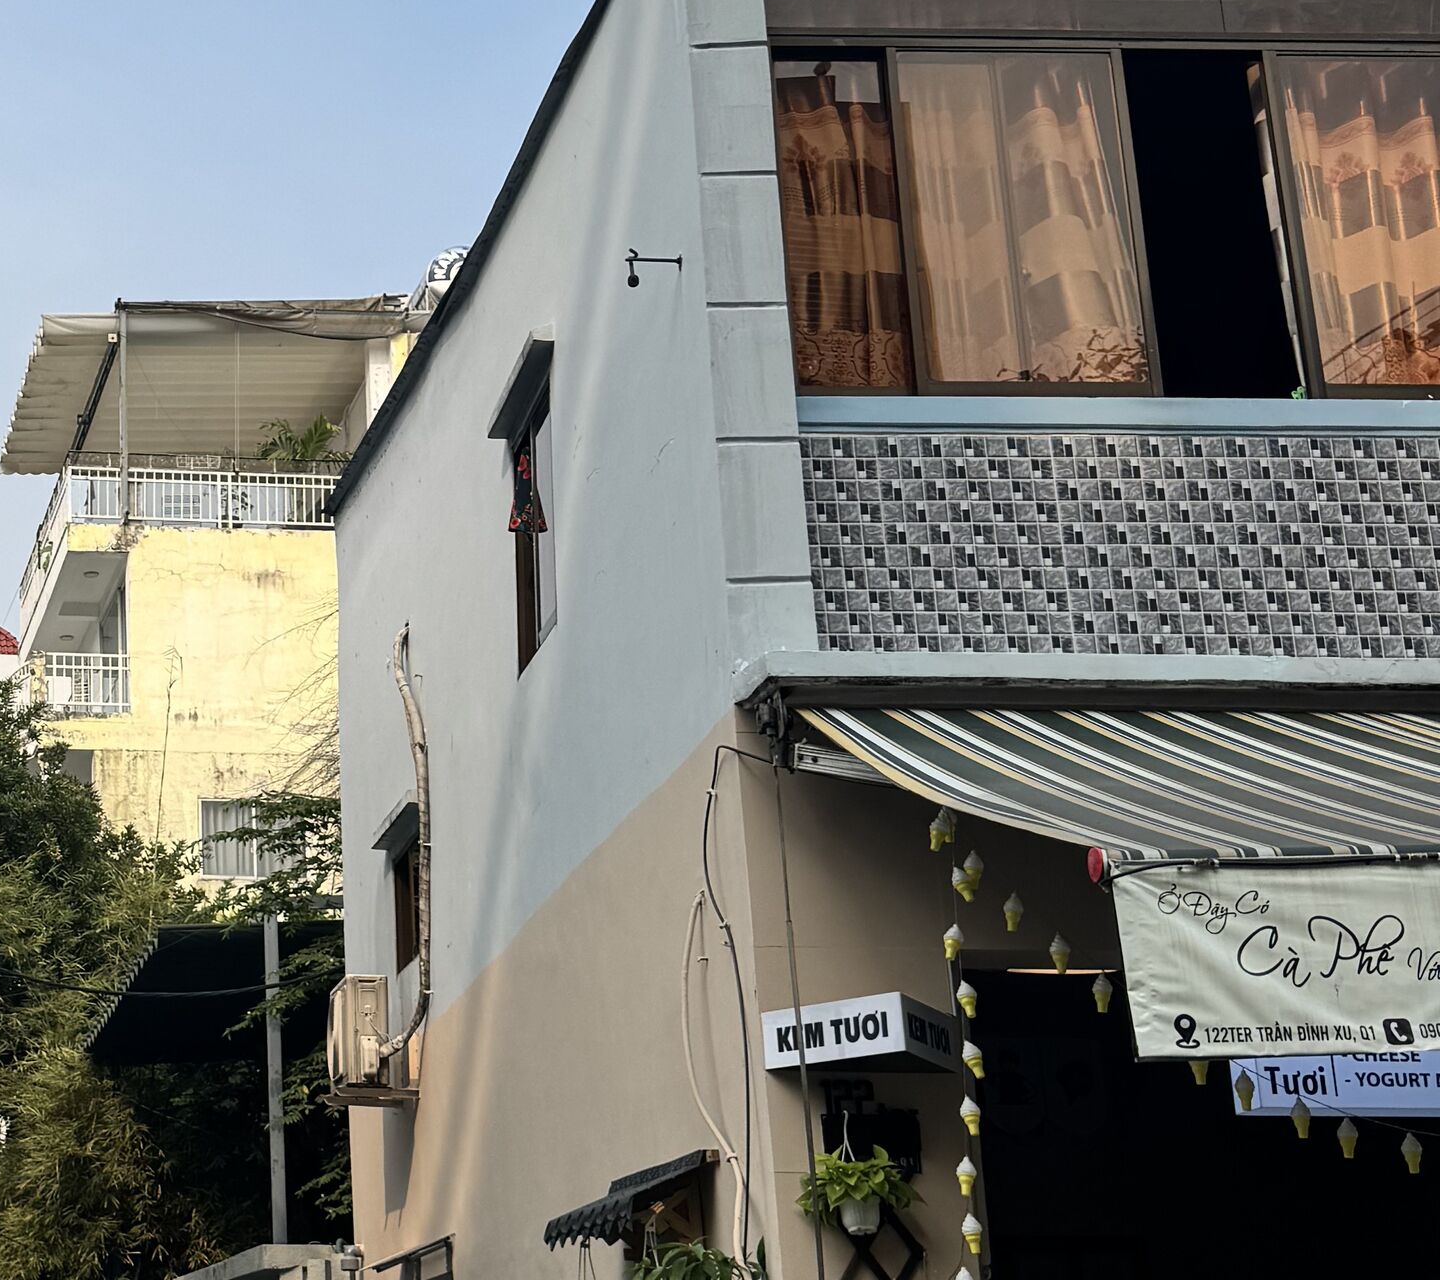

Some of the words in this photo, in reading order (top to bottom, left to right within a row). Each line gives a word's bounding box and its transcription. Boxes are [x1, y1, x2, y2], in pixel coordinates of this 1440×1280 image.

[1157, 883, 1181, 915] Ở
[1235, 890, 1271, 915] Có
[1237, 925, 1311, 988] Cà
[1308, 915, 1405, 978] Phê
[830, 1010, 889, 1044] TƯƠI
[1205, 1026, 1252, 1043] 122TER
[1256, 1021, 1293, 1042] TRẦN
[1297, 1022, 1329, 1041] ĐÌNH
[1360, 1025, 1376, 1041] Q1
[1263, 1065, 1329, 1097] Tươi
[1355, 1072, 1431, 1088] YOGURT
